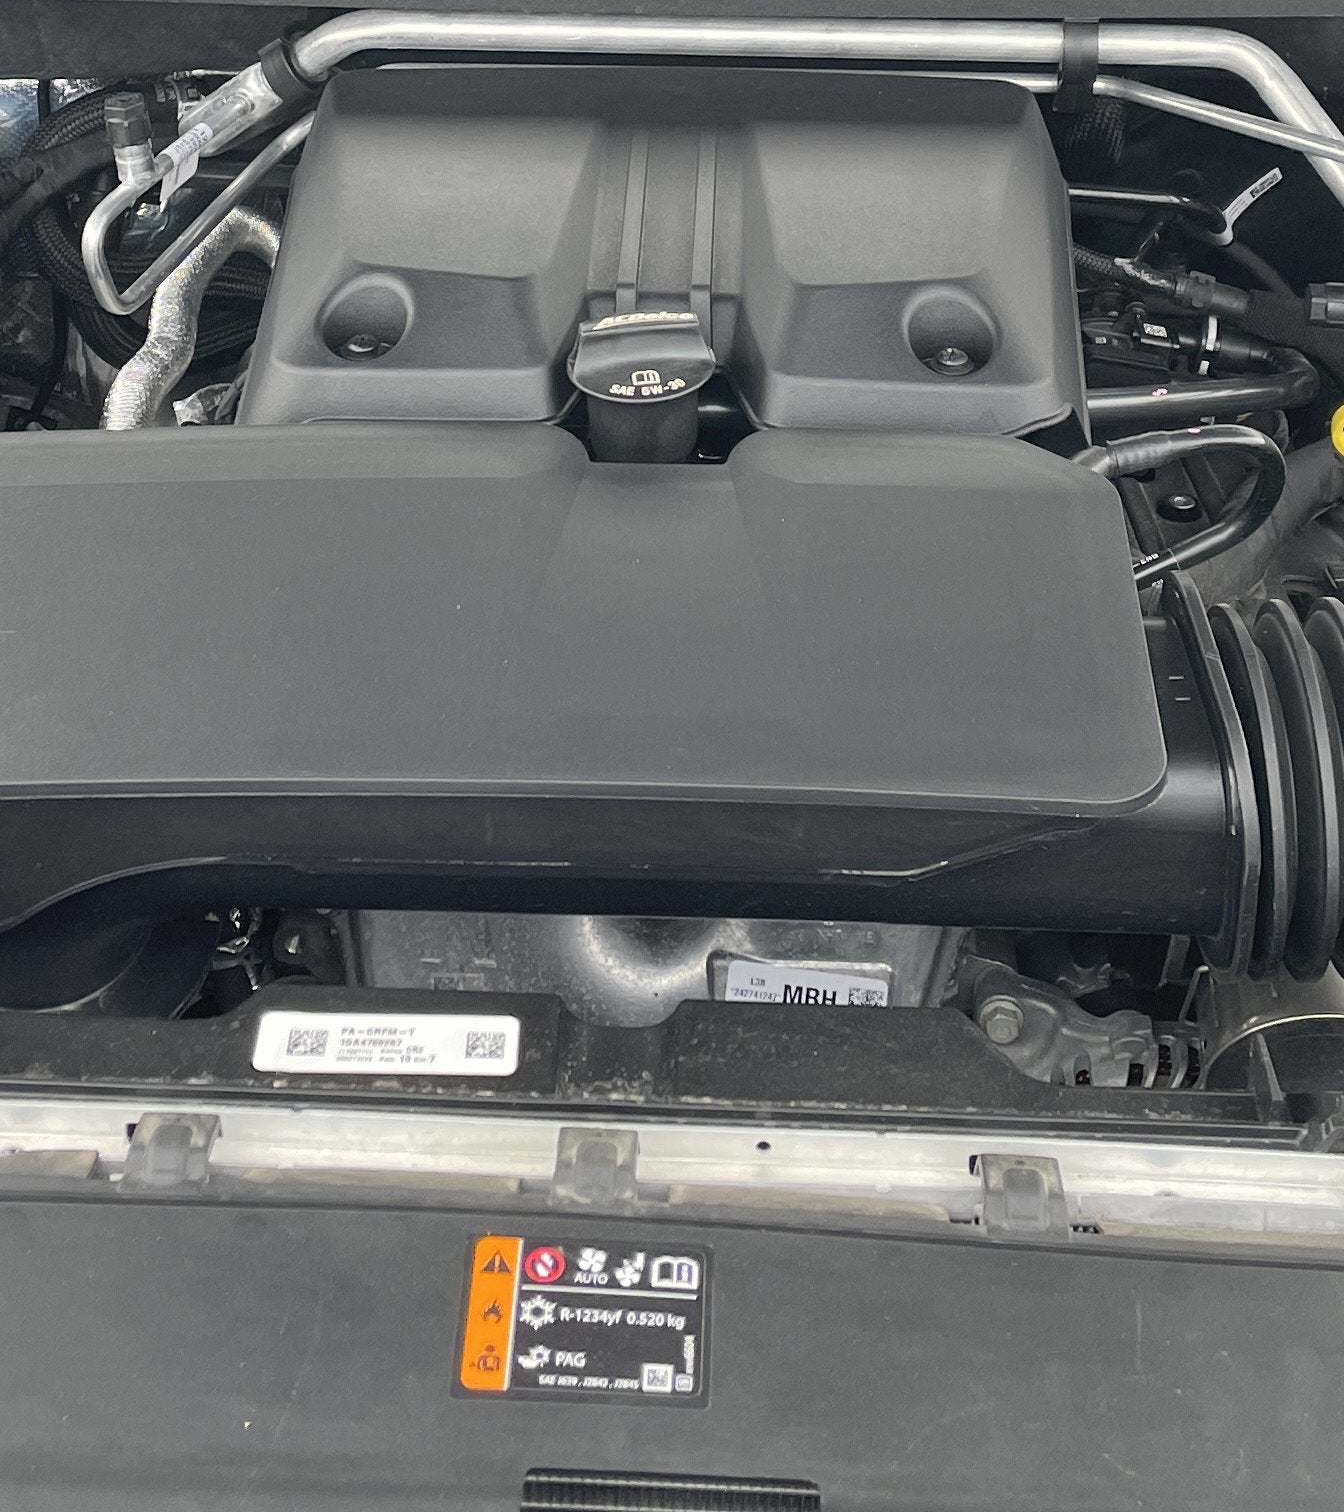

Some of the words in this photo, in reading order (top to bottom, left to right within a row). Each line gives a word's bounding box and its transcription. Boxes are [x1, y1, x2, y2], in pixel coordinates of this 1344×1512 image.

[609, 384, 635, 396] SAE
[783, 984, 837, 1006] MRH
[574, 1271, 608, 1285] AUTO
[560, 1306, 622, 1326] R-1234yf
[626, 1310, 665, 1328] 0.520
[667, 1314, 686, 1330] kg
[555, 1350, 587, 1368] PAG
